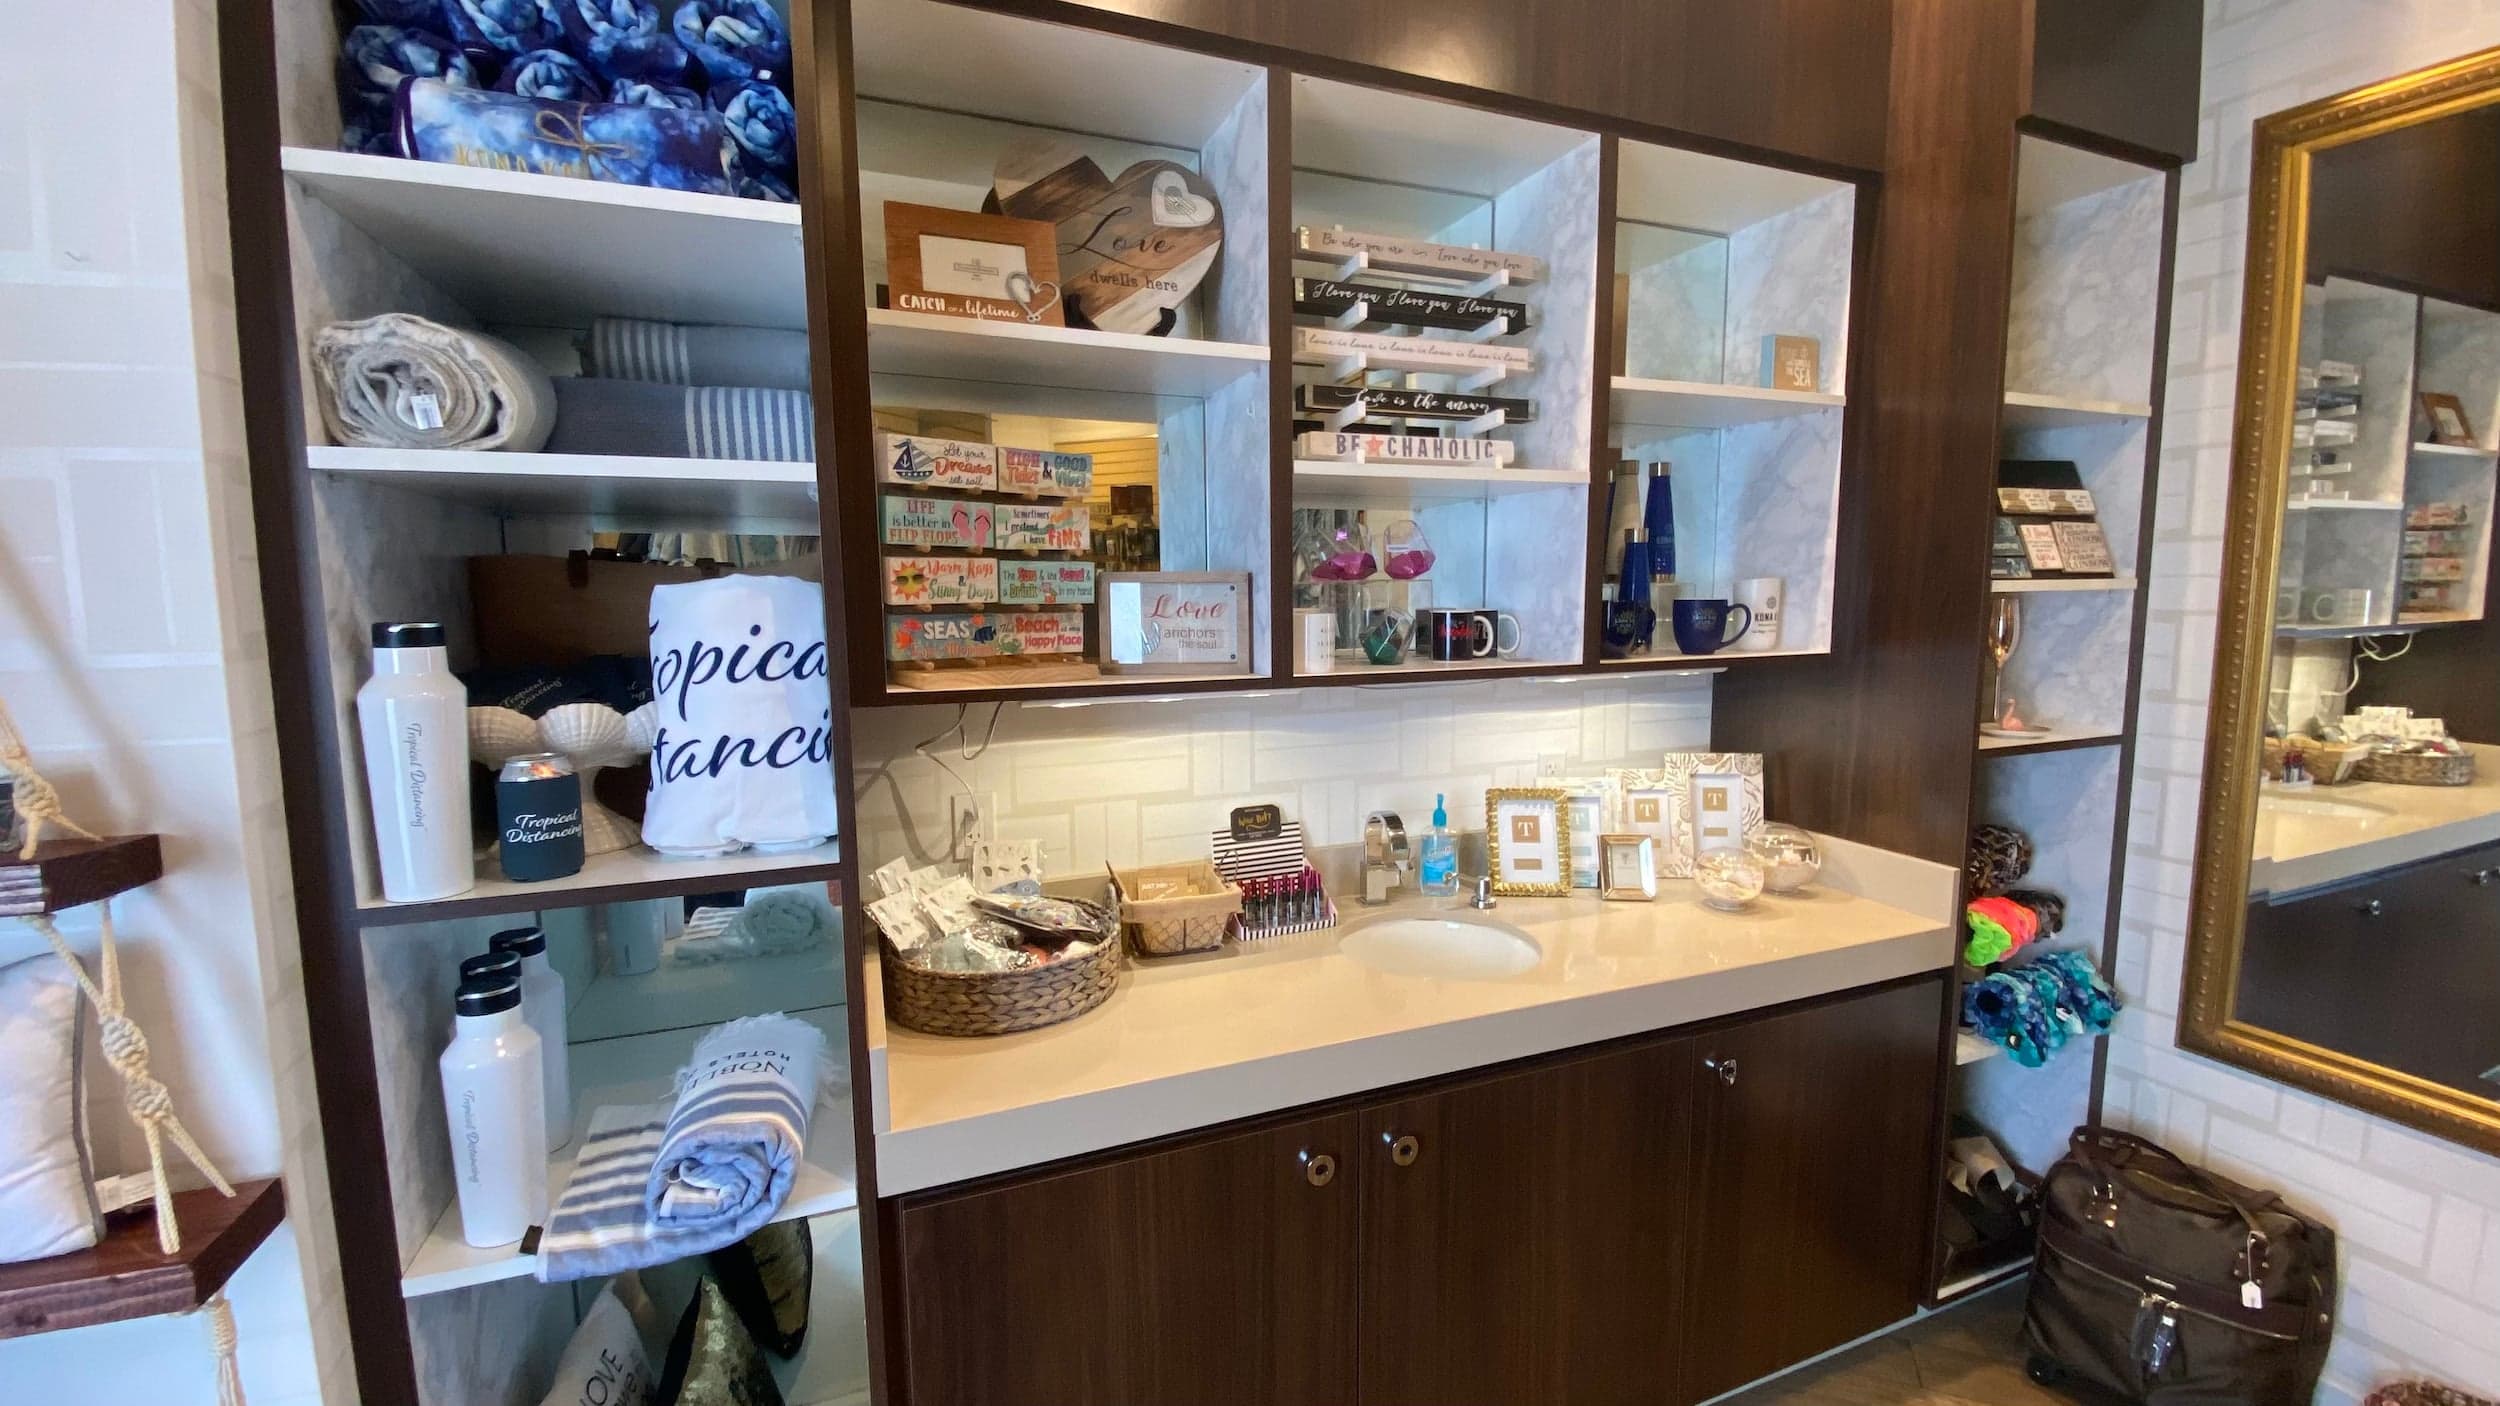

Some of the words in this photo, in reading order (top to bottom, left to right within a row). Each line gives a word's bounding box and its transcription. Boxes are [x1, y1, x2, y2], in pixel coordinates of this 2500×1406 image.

[1057, 206, 1177, 270] Love
[1090, 270, 1138, 288] dwells
[1145, 275, 1179, 292] here
[899, 294, 946, 312] CATCH
[965, 299, 1020, 321] lifetime
[1326, 284, 1356, 299] love
[1353, 290, 1381, 305] you
[1399, 293, 1428, 306] love
[1425, 300, 1451, 314] you
[1469, 300, 1496, 313] love
[1494, 306, 1519, 319] you
[1393, 396, 1407, 406] is
[1413, 393, 1441, 410] the
[932, 456, 993, 477] Dreams
[1041, 460, 1053, 481] &
[1054, 454, 1088, 472] GOOD
[892, 517, 901, 527] is
[902, 514, 939, 529] better
[941, 518, 952, 530] in
[889, 528, 919, 542] FLIP
[927, 578, 962, 603] Sunny
[967, 583, 994, 602] Days
[1144, 592, 1226, 622] Love
[923, 620, 971, 641] SEAS
[1015, 615, 1060, 634] Beach
[1162, 626, 1217, 640] anchors
[1024, 634, 1058, 649] Happy
[1057, 633, 1083, 646] Place
[1178, 638, 1194, 649] the
[1196, 639, 1218, 650] soul
[403, 722, 424, 767] Tropical
[409, 769, 427, 828] Distancing
[1706, 792, 1723, 806] T
[514, 808, 578, 831] Tropical
[1639, 803, 1656, 817] T
[1517, 821, 1534, 837] T
[579, 1348, 624, 1406] OVE
